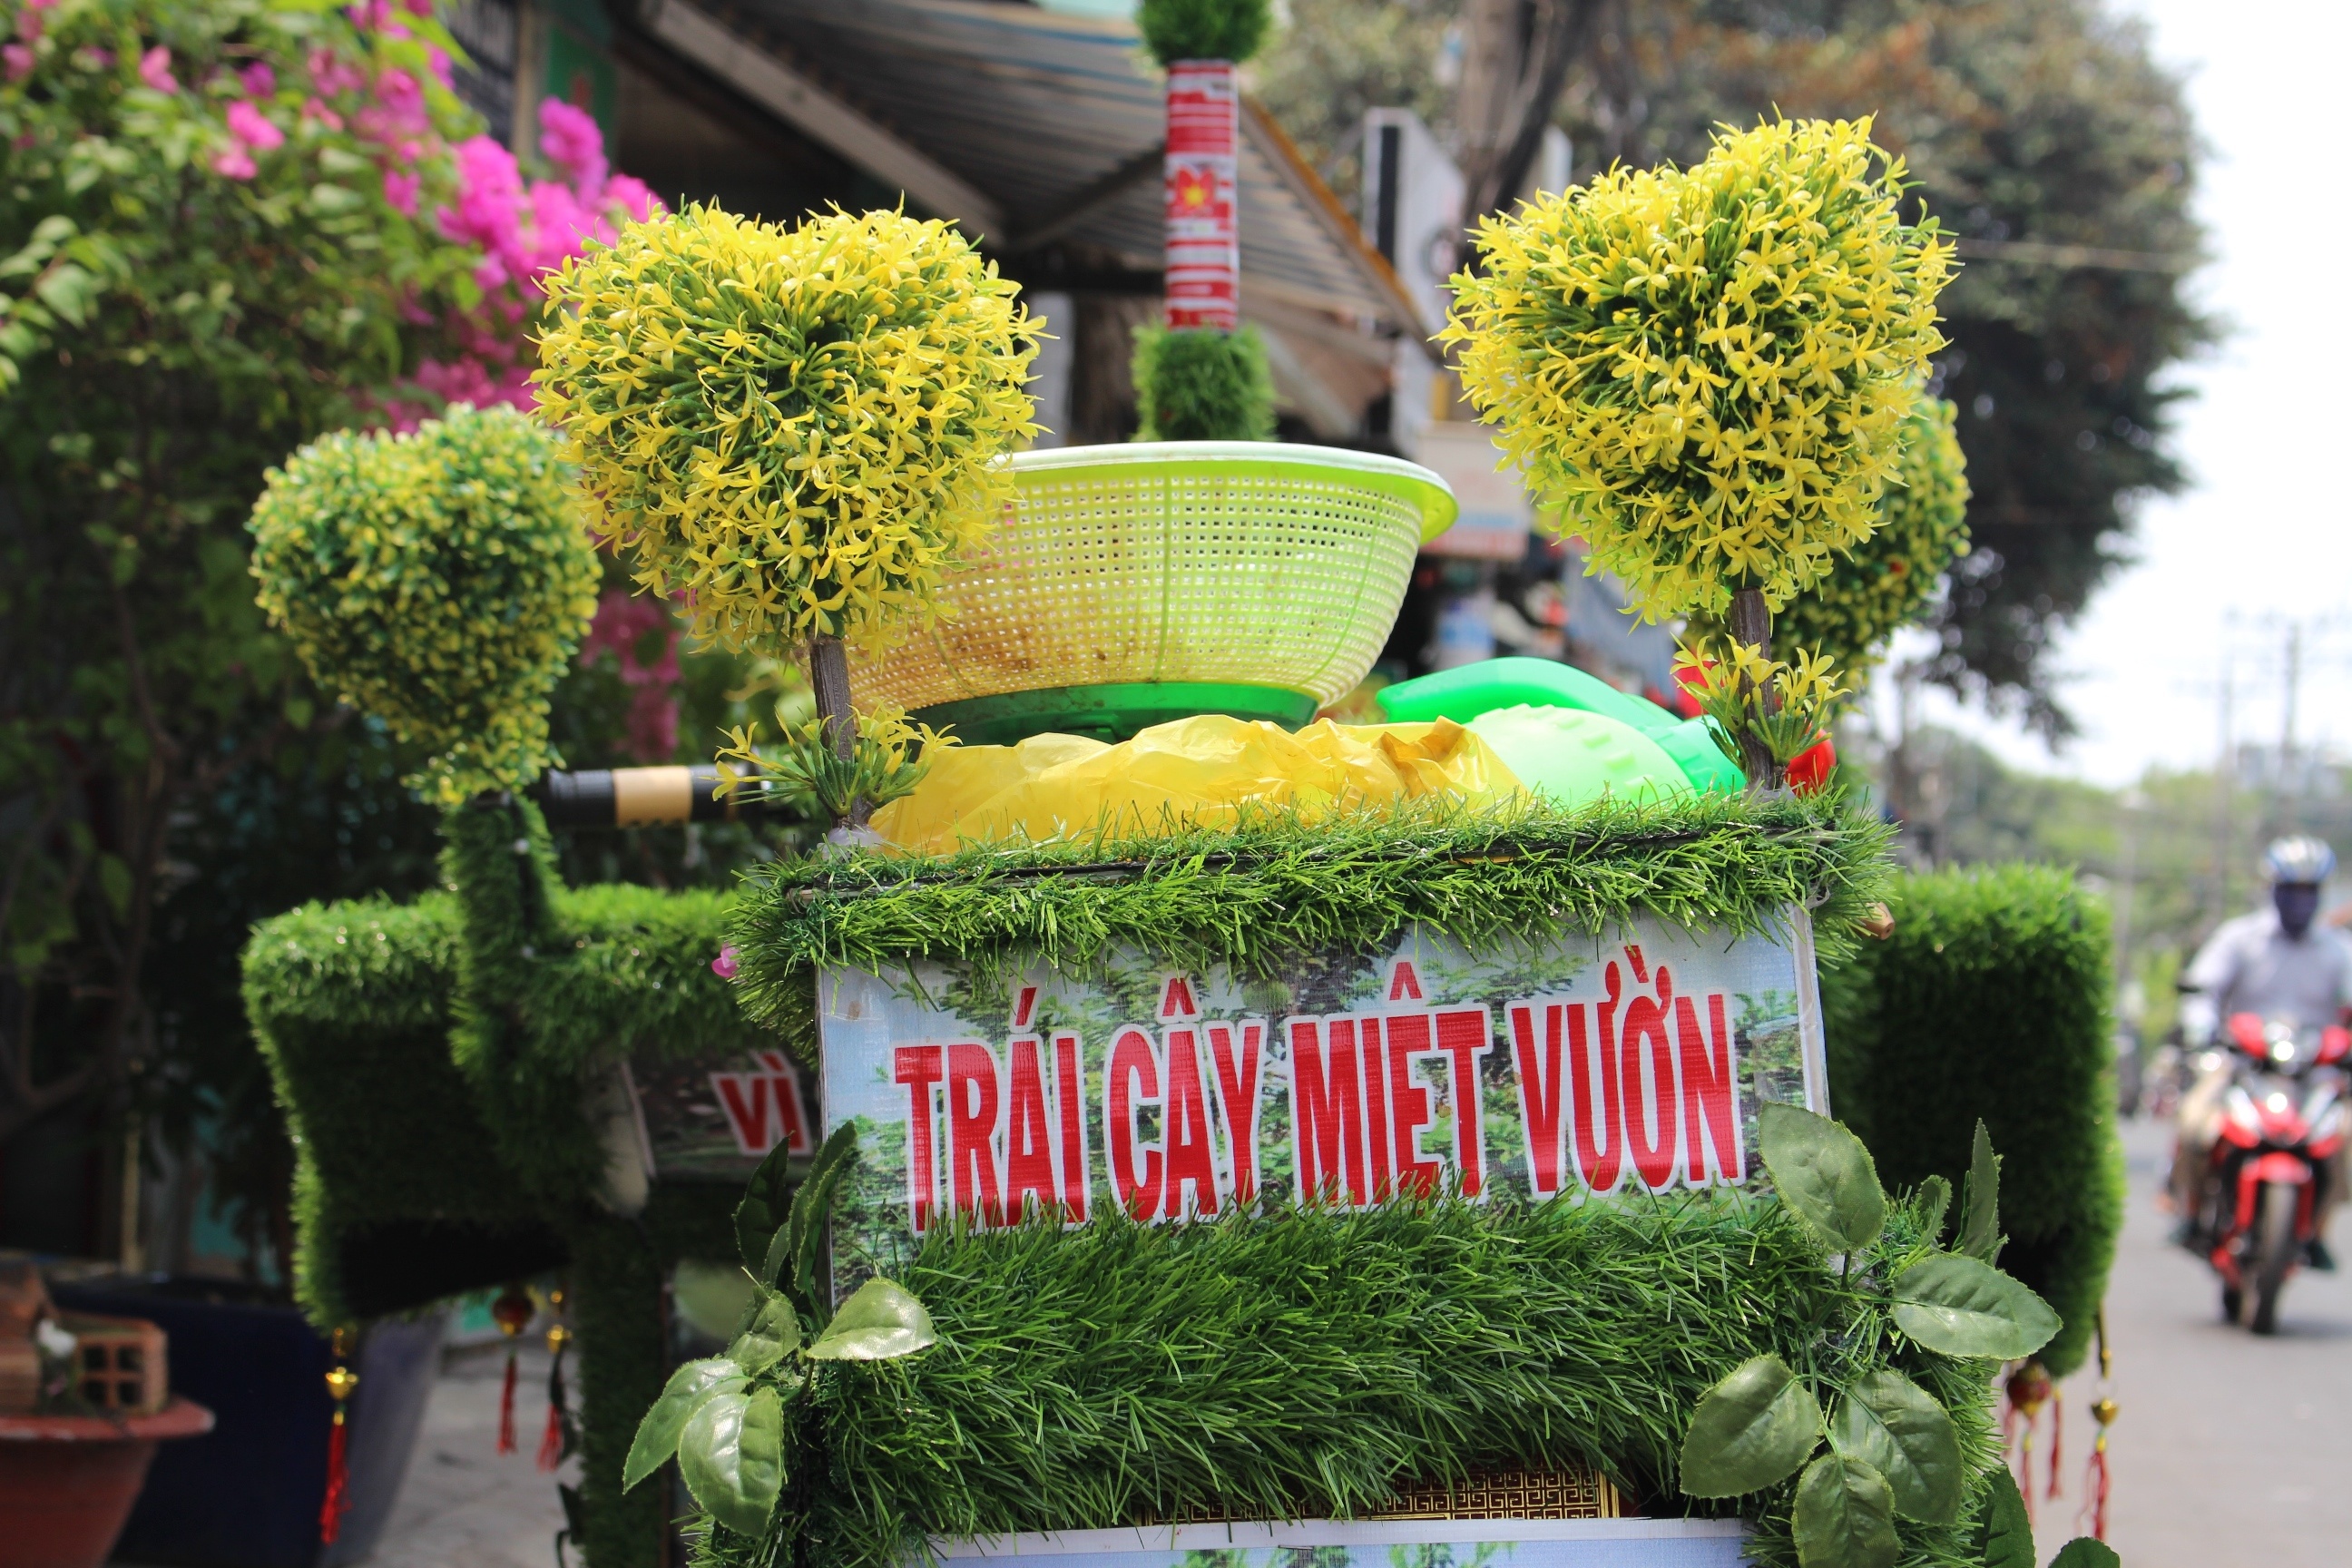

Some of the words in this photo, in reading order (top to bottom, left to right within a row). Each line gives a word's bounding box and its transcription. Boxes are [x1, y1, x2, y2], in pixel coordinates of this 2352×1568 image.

[895, 986, 1086, 1231] TRÁI
[1109, 976, 1262, 1224] CÂY
[1511, 945, 1740, 1193] VƯỜN
